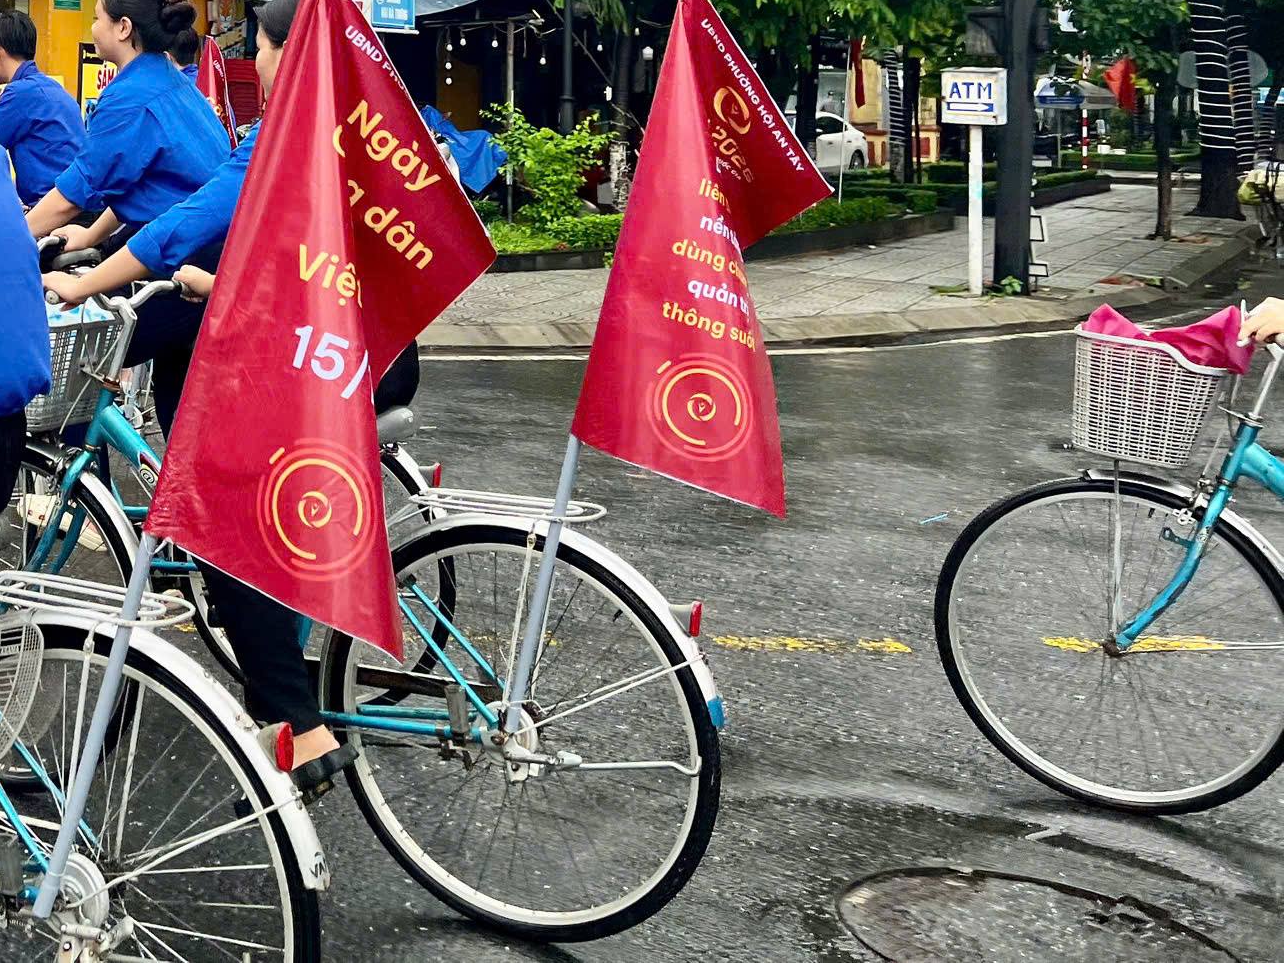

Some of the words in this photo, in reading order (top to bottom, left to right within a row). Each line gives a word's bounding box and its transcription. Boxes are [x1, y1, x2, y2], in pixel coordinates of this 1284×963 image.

[344, 25, 384, 63] UBND
[700, 18, 726, 53] UBND
[724, 54, 760, 106] PHƯỜNG
[757, 104, 776, 129] HỘI
[772, 129, 789, 149] AN
[785, 150, 805, 172] TÂY
[949, 82, 992, 99] ATM
[346, 99, 441, 193] Ngày
[699, 178, 726, 207] liên
[364, 205, 435, 271] dân
[700, 215, 730, 240] nền
[672, 238, 726, 273] dùng
[687, 278, 738, 309] quản
[662, 300, 726, 340] thông
